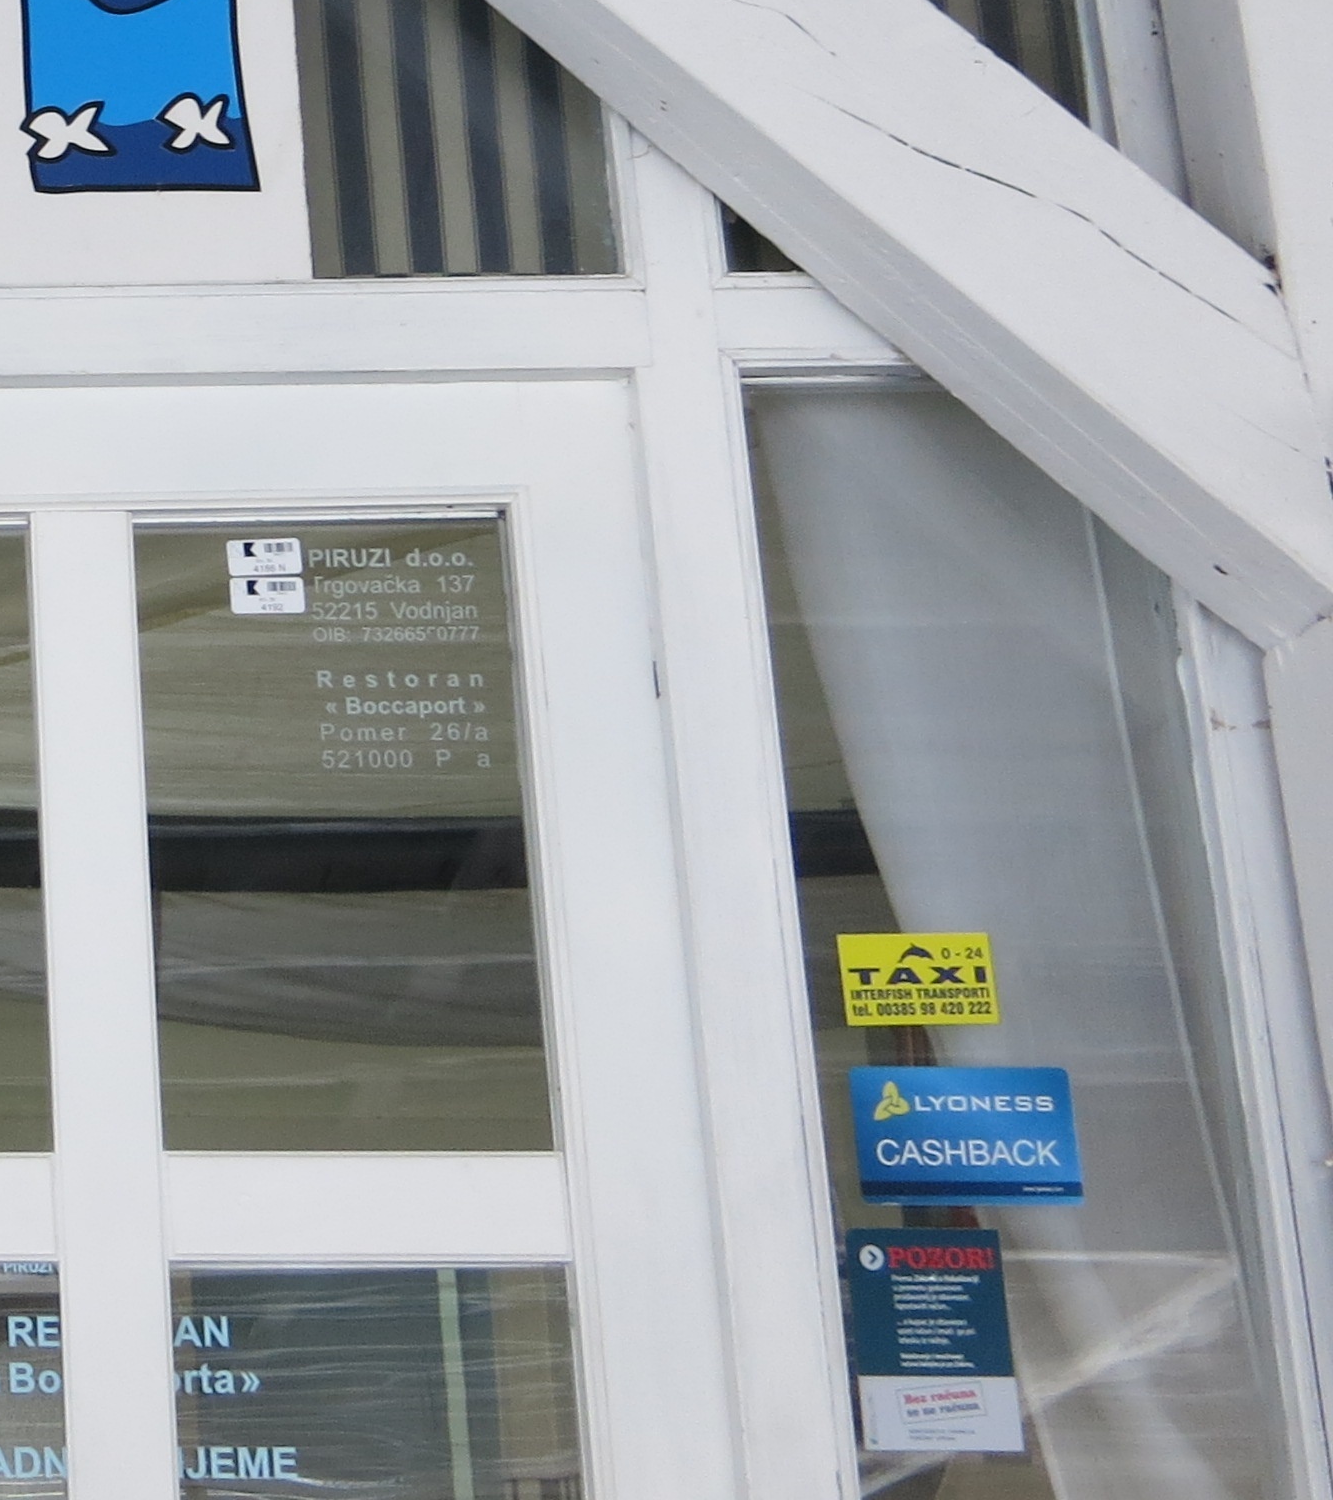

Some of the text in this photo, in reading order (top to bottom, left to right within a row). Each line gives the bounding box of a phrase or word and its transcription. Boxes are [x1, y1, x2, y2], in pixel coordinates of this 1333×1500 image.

[308, 548, 475, 568] PIRUZI d.o.o.
[313, 574, 475, 598] Trgovačka 137
[311, 601, 478, 623] 52215 Vodnjan
[312, 626, 351, 643] OIB:
[316, 670, 484, 688] Restoran
[320, 722, 489, 742] Pomer 26/a
[321, 750, 414, 768] 521000
[965, 947, 984, 959] 24
[847, 966, 987, 985] TAXI
[850, 987, 990, 1000] INTERFISH TRANSPORTI
[852, 1002, 992, 1016] tel. 00385 98 420 222
[914, 1095, 1054, 1112] LYONESS
[876, 1138, 1061, 1167] CASHBACK
[886, 1247, 996, 1271] POZOR!
